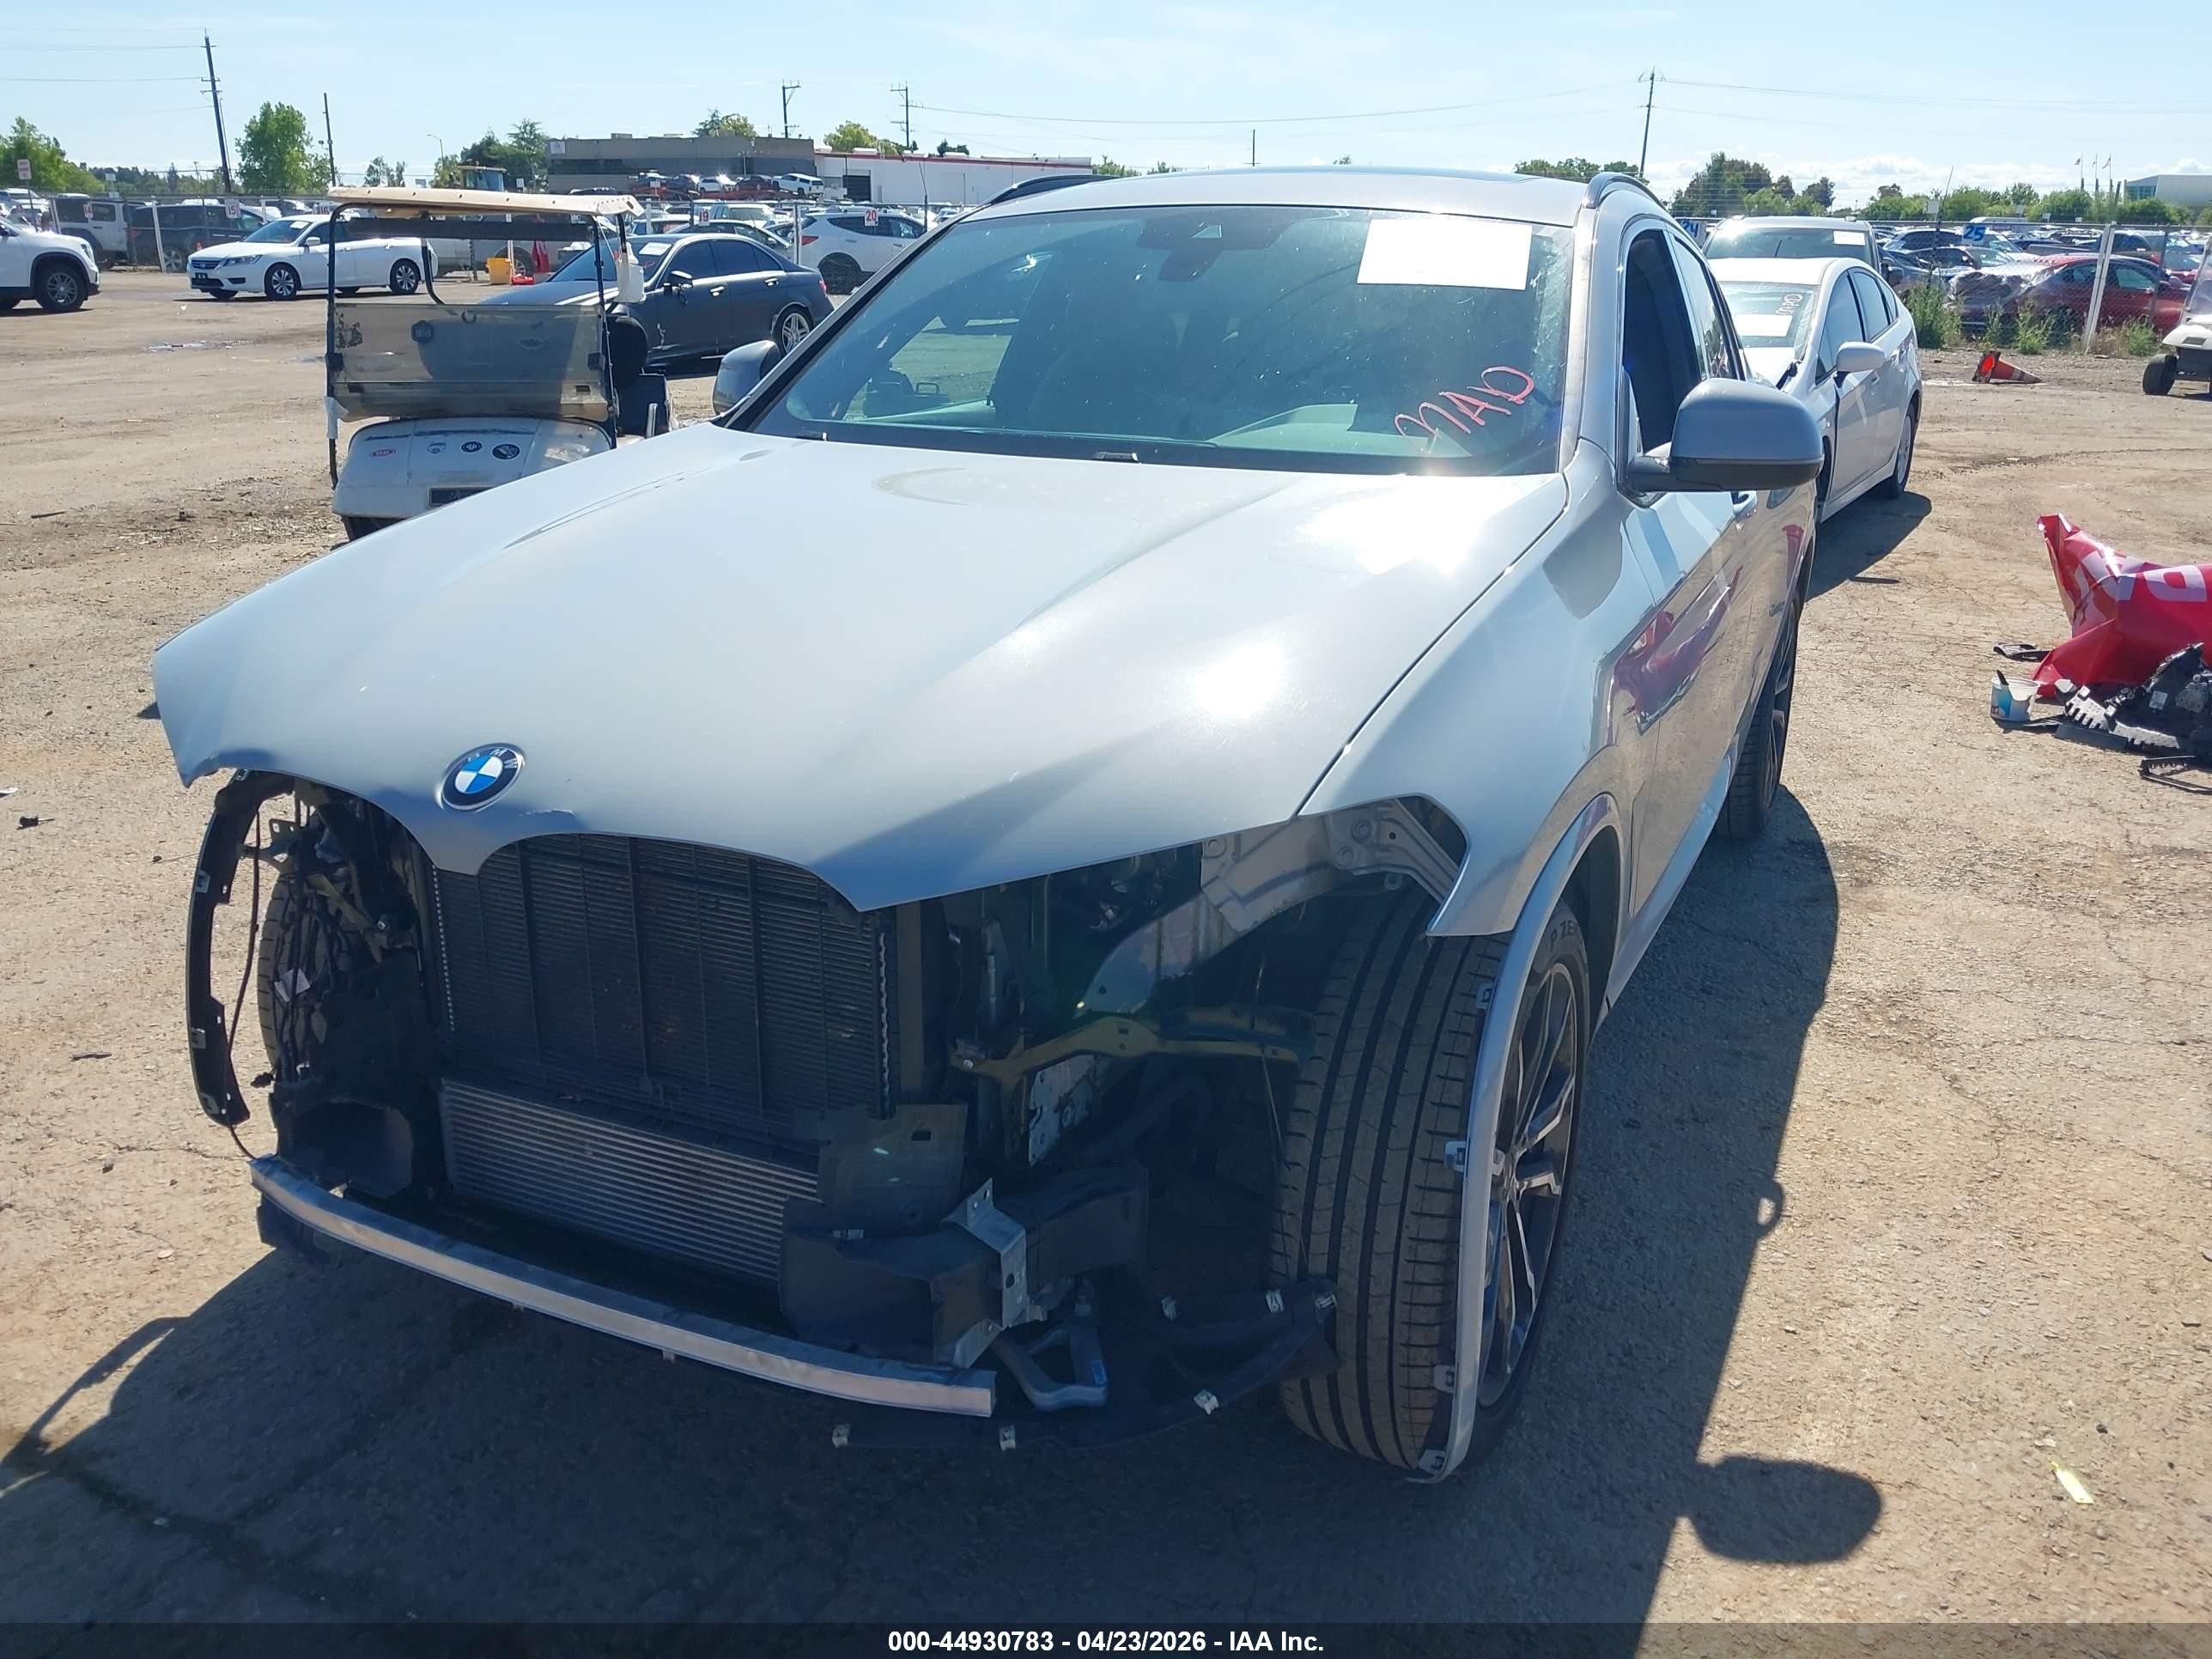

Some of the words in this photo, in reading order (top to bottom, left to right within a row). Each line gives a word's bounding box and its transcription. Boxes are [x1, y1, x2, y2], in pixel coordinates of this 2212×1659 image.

[699, 210, 709, 222] 19
[866, 210, 877, 222] 20
[1964, 225, 1986, 241] 25
[1394, 366, 1534, 453] MAD
